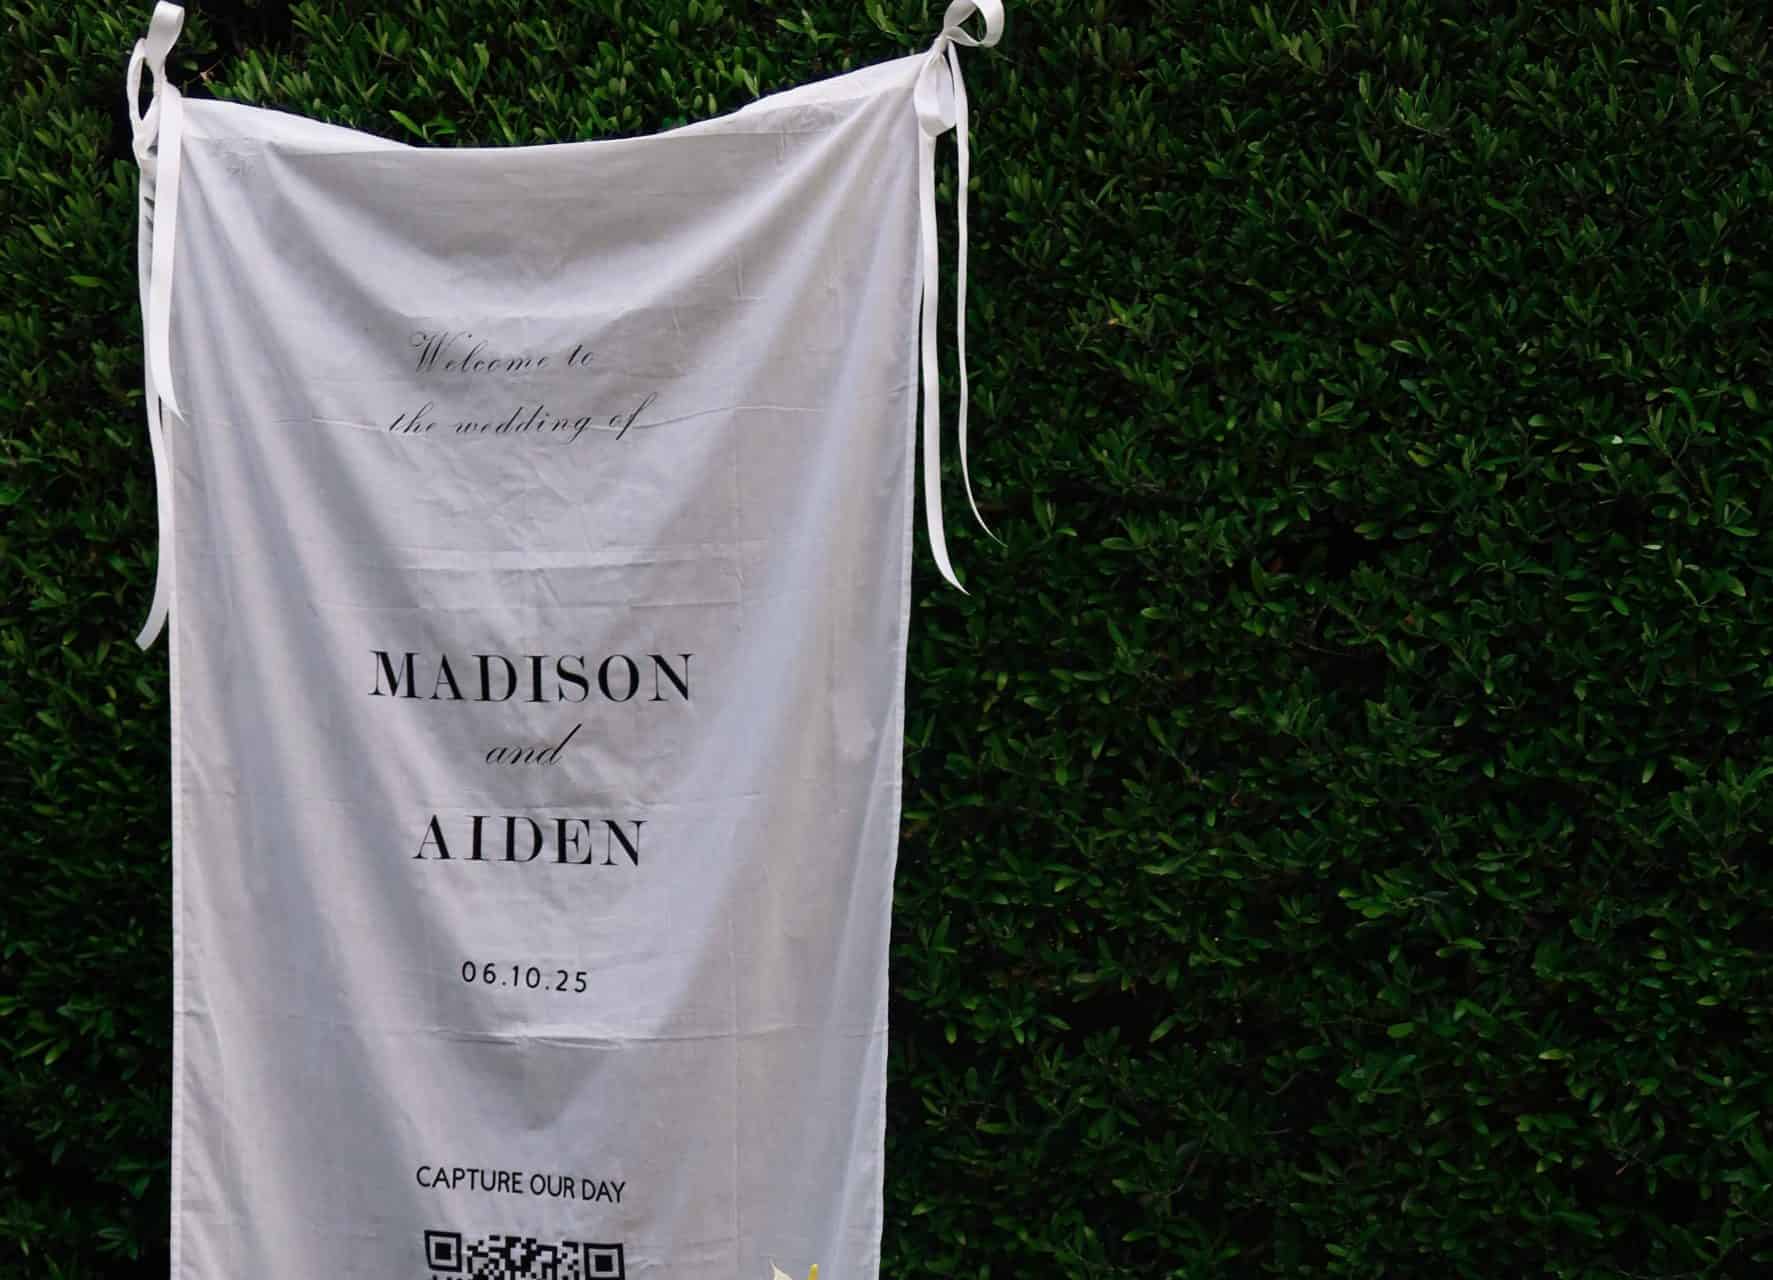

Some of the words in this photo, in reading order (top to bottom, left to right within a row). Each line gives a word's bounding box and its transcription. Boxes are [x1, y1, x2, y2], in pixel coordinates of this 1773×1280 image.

[411, 331, 549, 373] Welcome
[568, 344, 594, 369] to
[389, 401, 435, 434] the
[453, 404, 593, 446] wedding
[608, 391, 658, 440] of
[368, 650, 696, 703] MADISON
[485, 723, 582, 765] and
[412, 814, 649, 867] AIDEN
[461, 961, 588, 994] 06.10.25
[416, 1165, 523, 1194] CAPTURE
[530, 1173, 575, 1199] OUR
[581, 1178, 626, 1204] DAY
